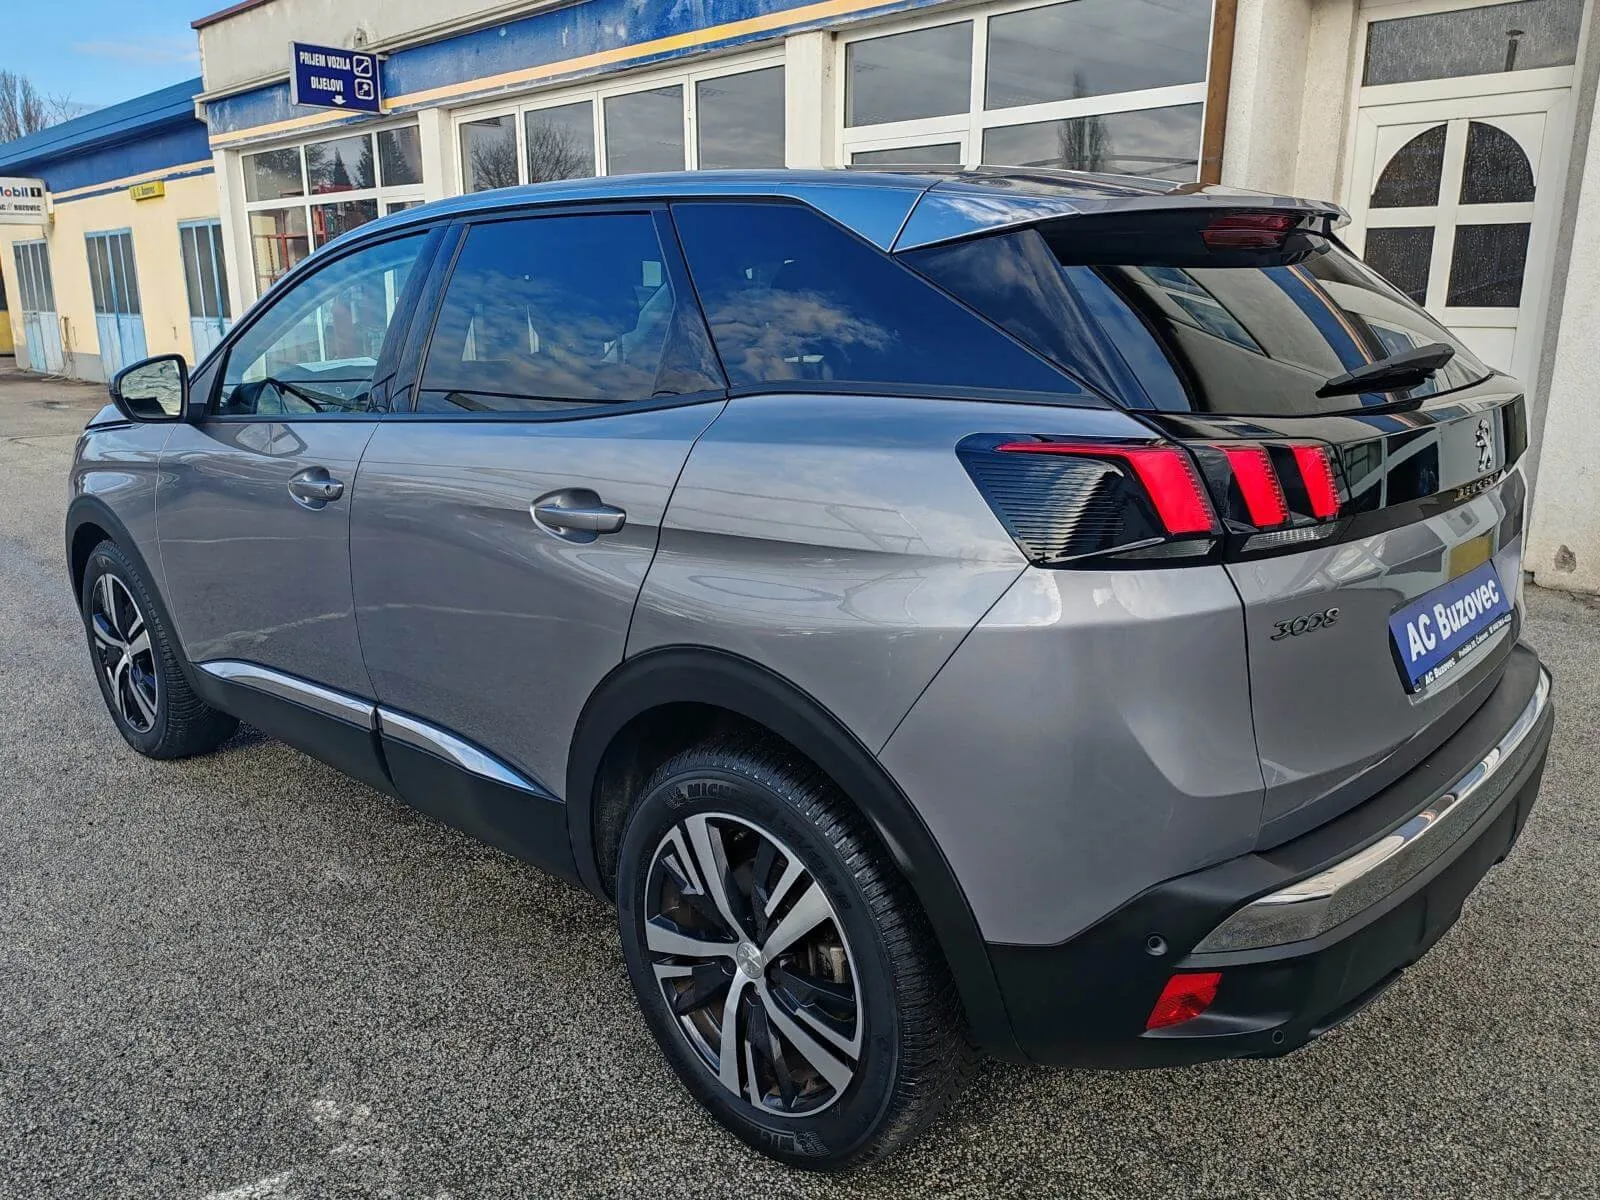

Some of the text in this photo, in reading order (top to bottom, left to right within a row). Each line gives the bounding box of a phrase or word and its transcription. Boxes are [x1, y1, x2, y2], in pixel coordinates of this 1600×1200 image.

[300, 51, 351, 71] PRIJEM VOZILA
[310, 76, 344, 92] DIJELOVI
[1270, 607, 1340, 641] 3008
[1406, 613, 1436, 662] AC
[1433, 579, 1499, 640] Buzovec
[1425, 671, 1435, 685] AC
